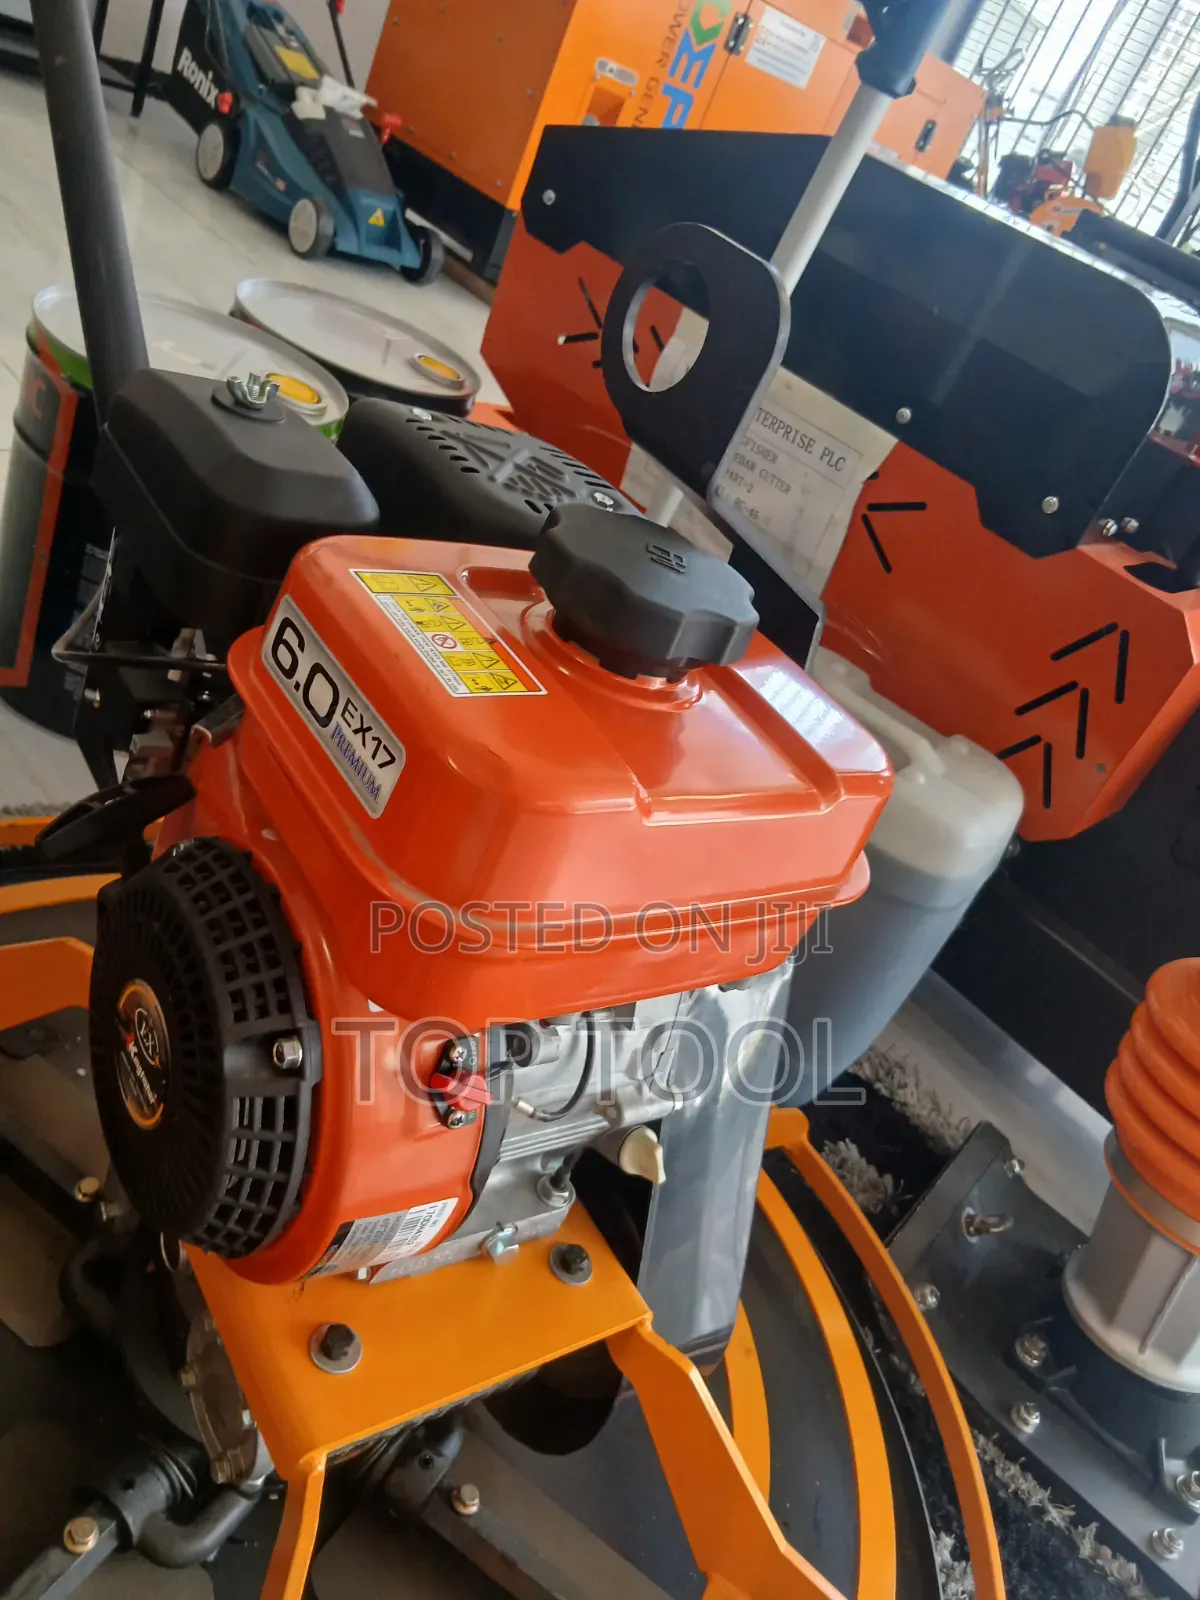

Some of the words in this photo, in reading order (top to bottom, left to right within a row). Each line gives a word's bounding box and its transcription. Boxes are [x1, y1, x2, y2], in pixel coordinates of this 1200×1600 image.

[177, 46, 219, 110] Ronix
[755, 406, 817, 454] TERPRISE
[819, 446, 847, 473] PLC
[759, 468, 792, 496] CUTTER
[271, 616, 340, 728] 6.0
[340, 697, 396, 770] EX17
[331, 722, 382, 800] PREMIUM
